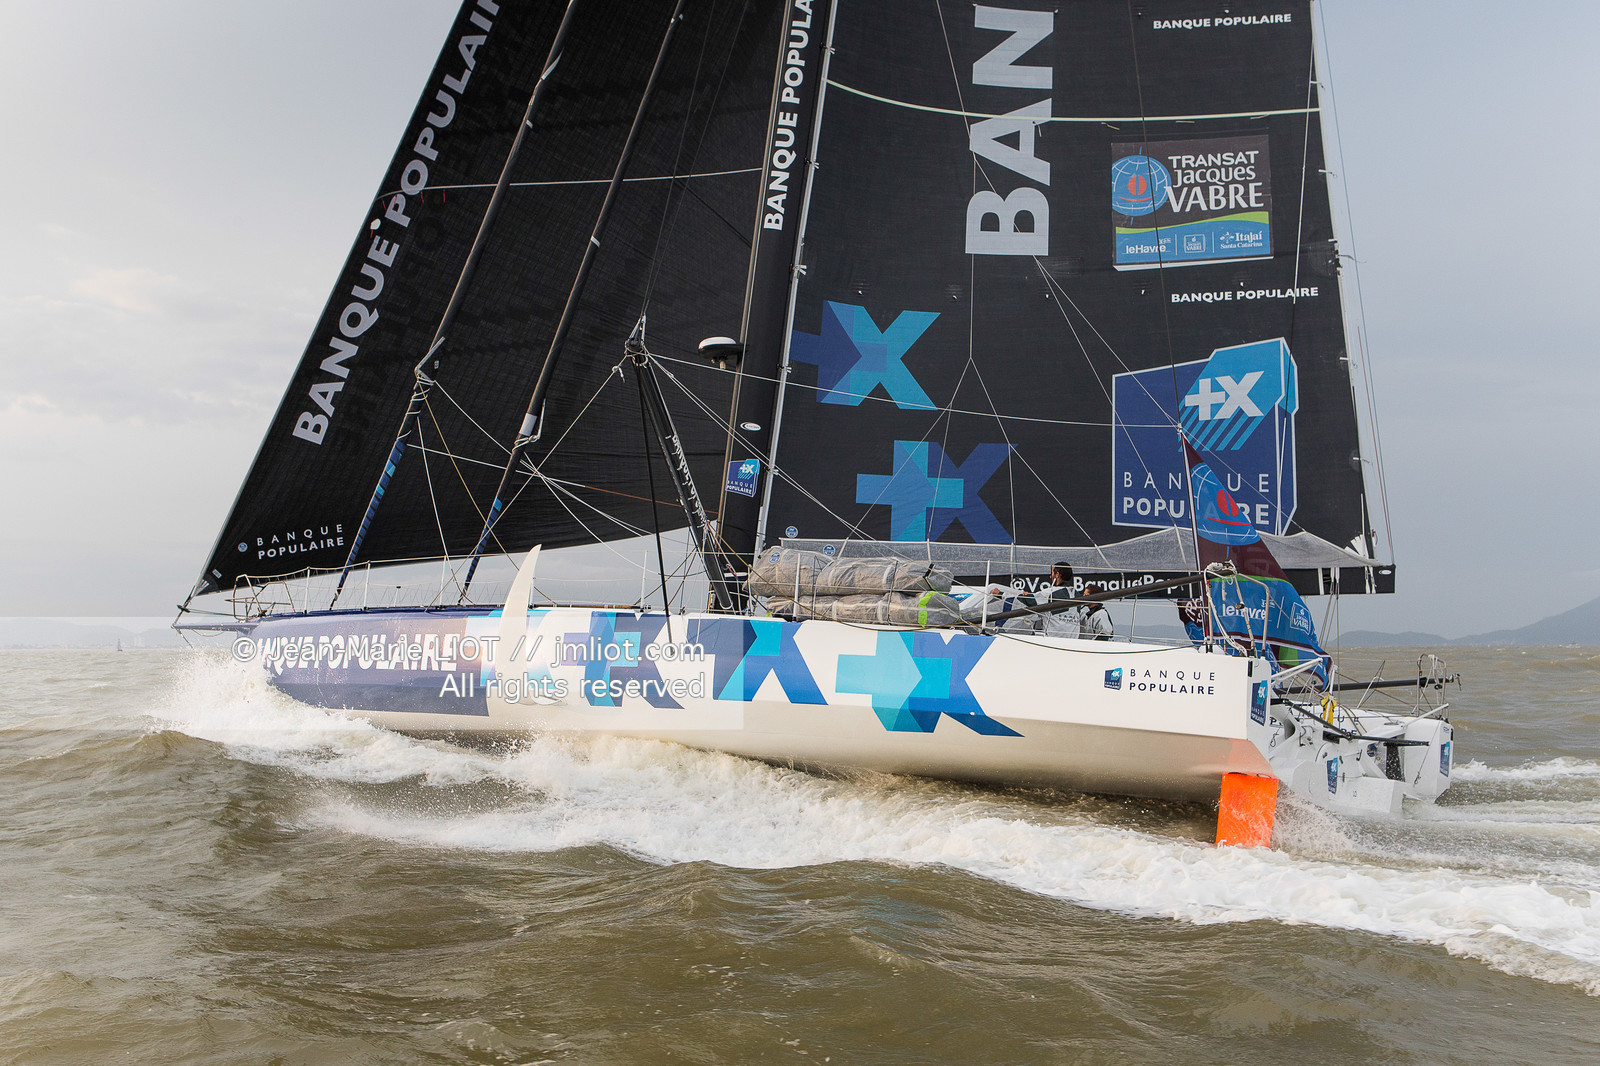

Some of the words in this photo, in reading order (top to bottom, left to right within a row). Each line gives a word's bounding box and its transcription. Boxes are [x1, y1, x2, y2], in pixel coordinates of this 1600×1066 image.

[1153, 18, 1211, 30] BANQUE
[1214, 13, 1292, 27] POPULAIRE
[763, 112, 798, 231] BANQUE
[781, 0, 813, 104] POPULA
[965, 4, 1055, 256] BAN
[1168, 150, 1259, 169] TRANSAT
[1163, 182, 1265, 213] VABRE
[1171, 291, 1233, 303] BANQUE
[1236, 287, 1319, 301] POPULAIRE
[292, 235, 399, 445] BANQUE
[1123, 471, 1270, 493] BANUE
[256, 523, 343, 547] BANQUE
[257, 536, 345, 560] POPULAIRE
[1130, 669, 1215, 681] BANQUE
[1129, 682, 1214, 695] POPULAIRE
